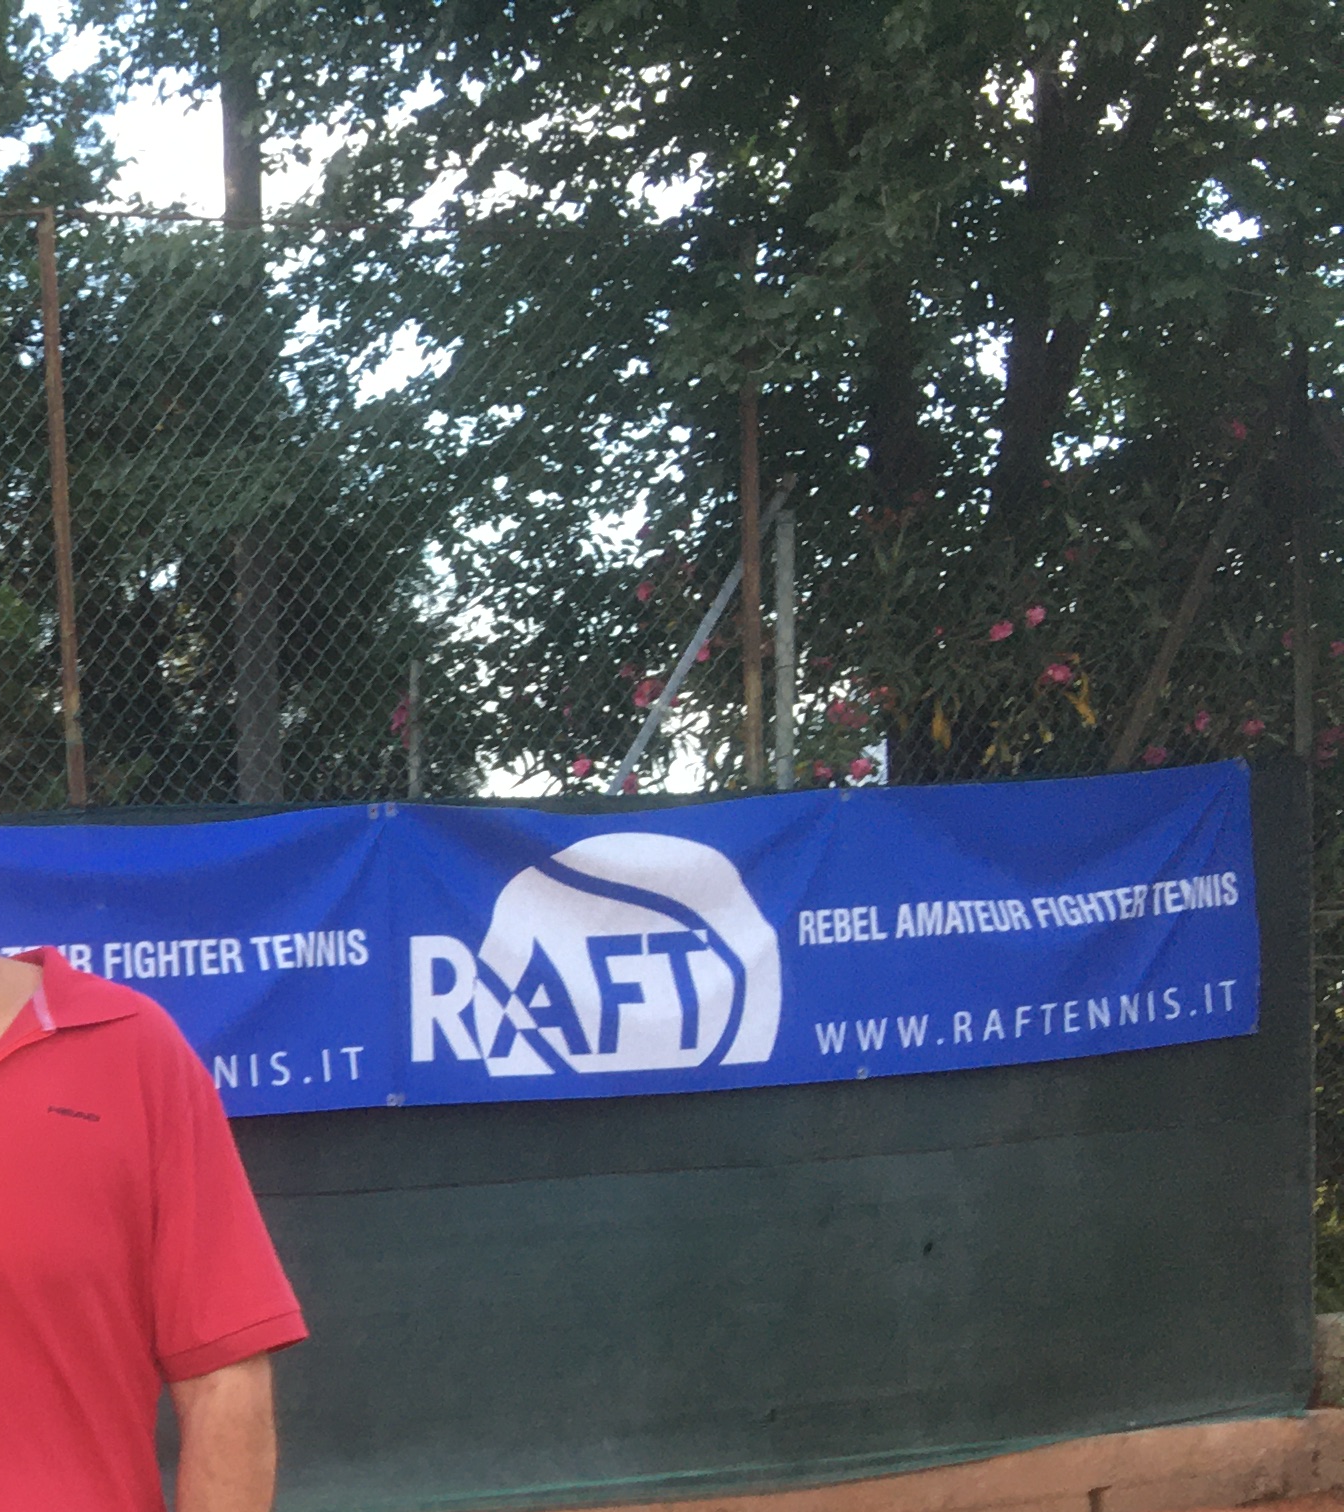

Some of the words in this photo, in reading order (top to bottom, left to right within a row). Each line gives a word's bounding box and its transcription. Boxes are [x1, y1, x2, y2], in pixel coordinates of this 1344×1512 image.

[799, 907, 888, 946] REBEL
[896, 900, 1032, 939] AMATEUR
[1031, 884, 1147, 930] FIGHTER
[1150, 871, 1239, 915] TENNIS
[103, 939, 246, 979] FIGHTER
[250, 929, 370, 972] TENNIS
[409, 929, 708, 1062] RAFT
[815, 979, 1238, 1056] WWW.RAFTENNIS.IT
